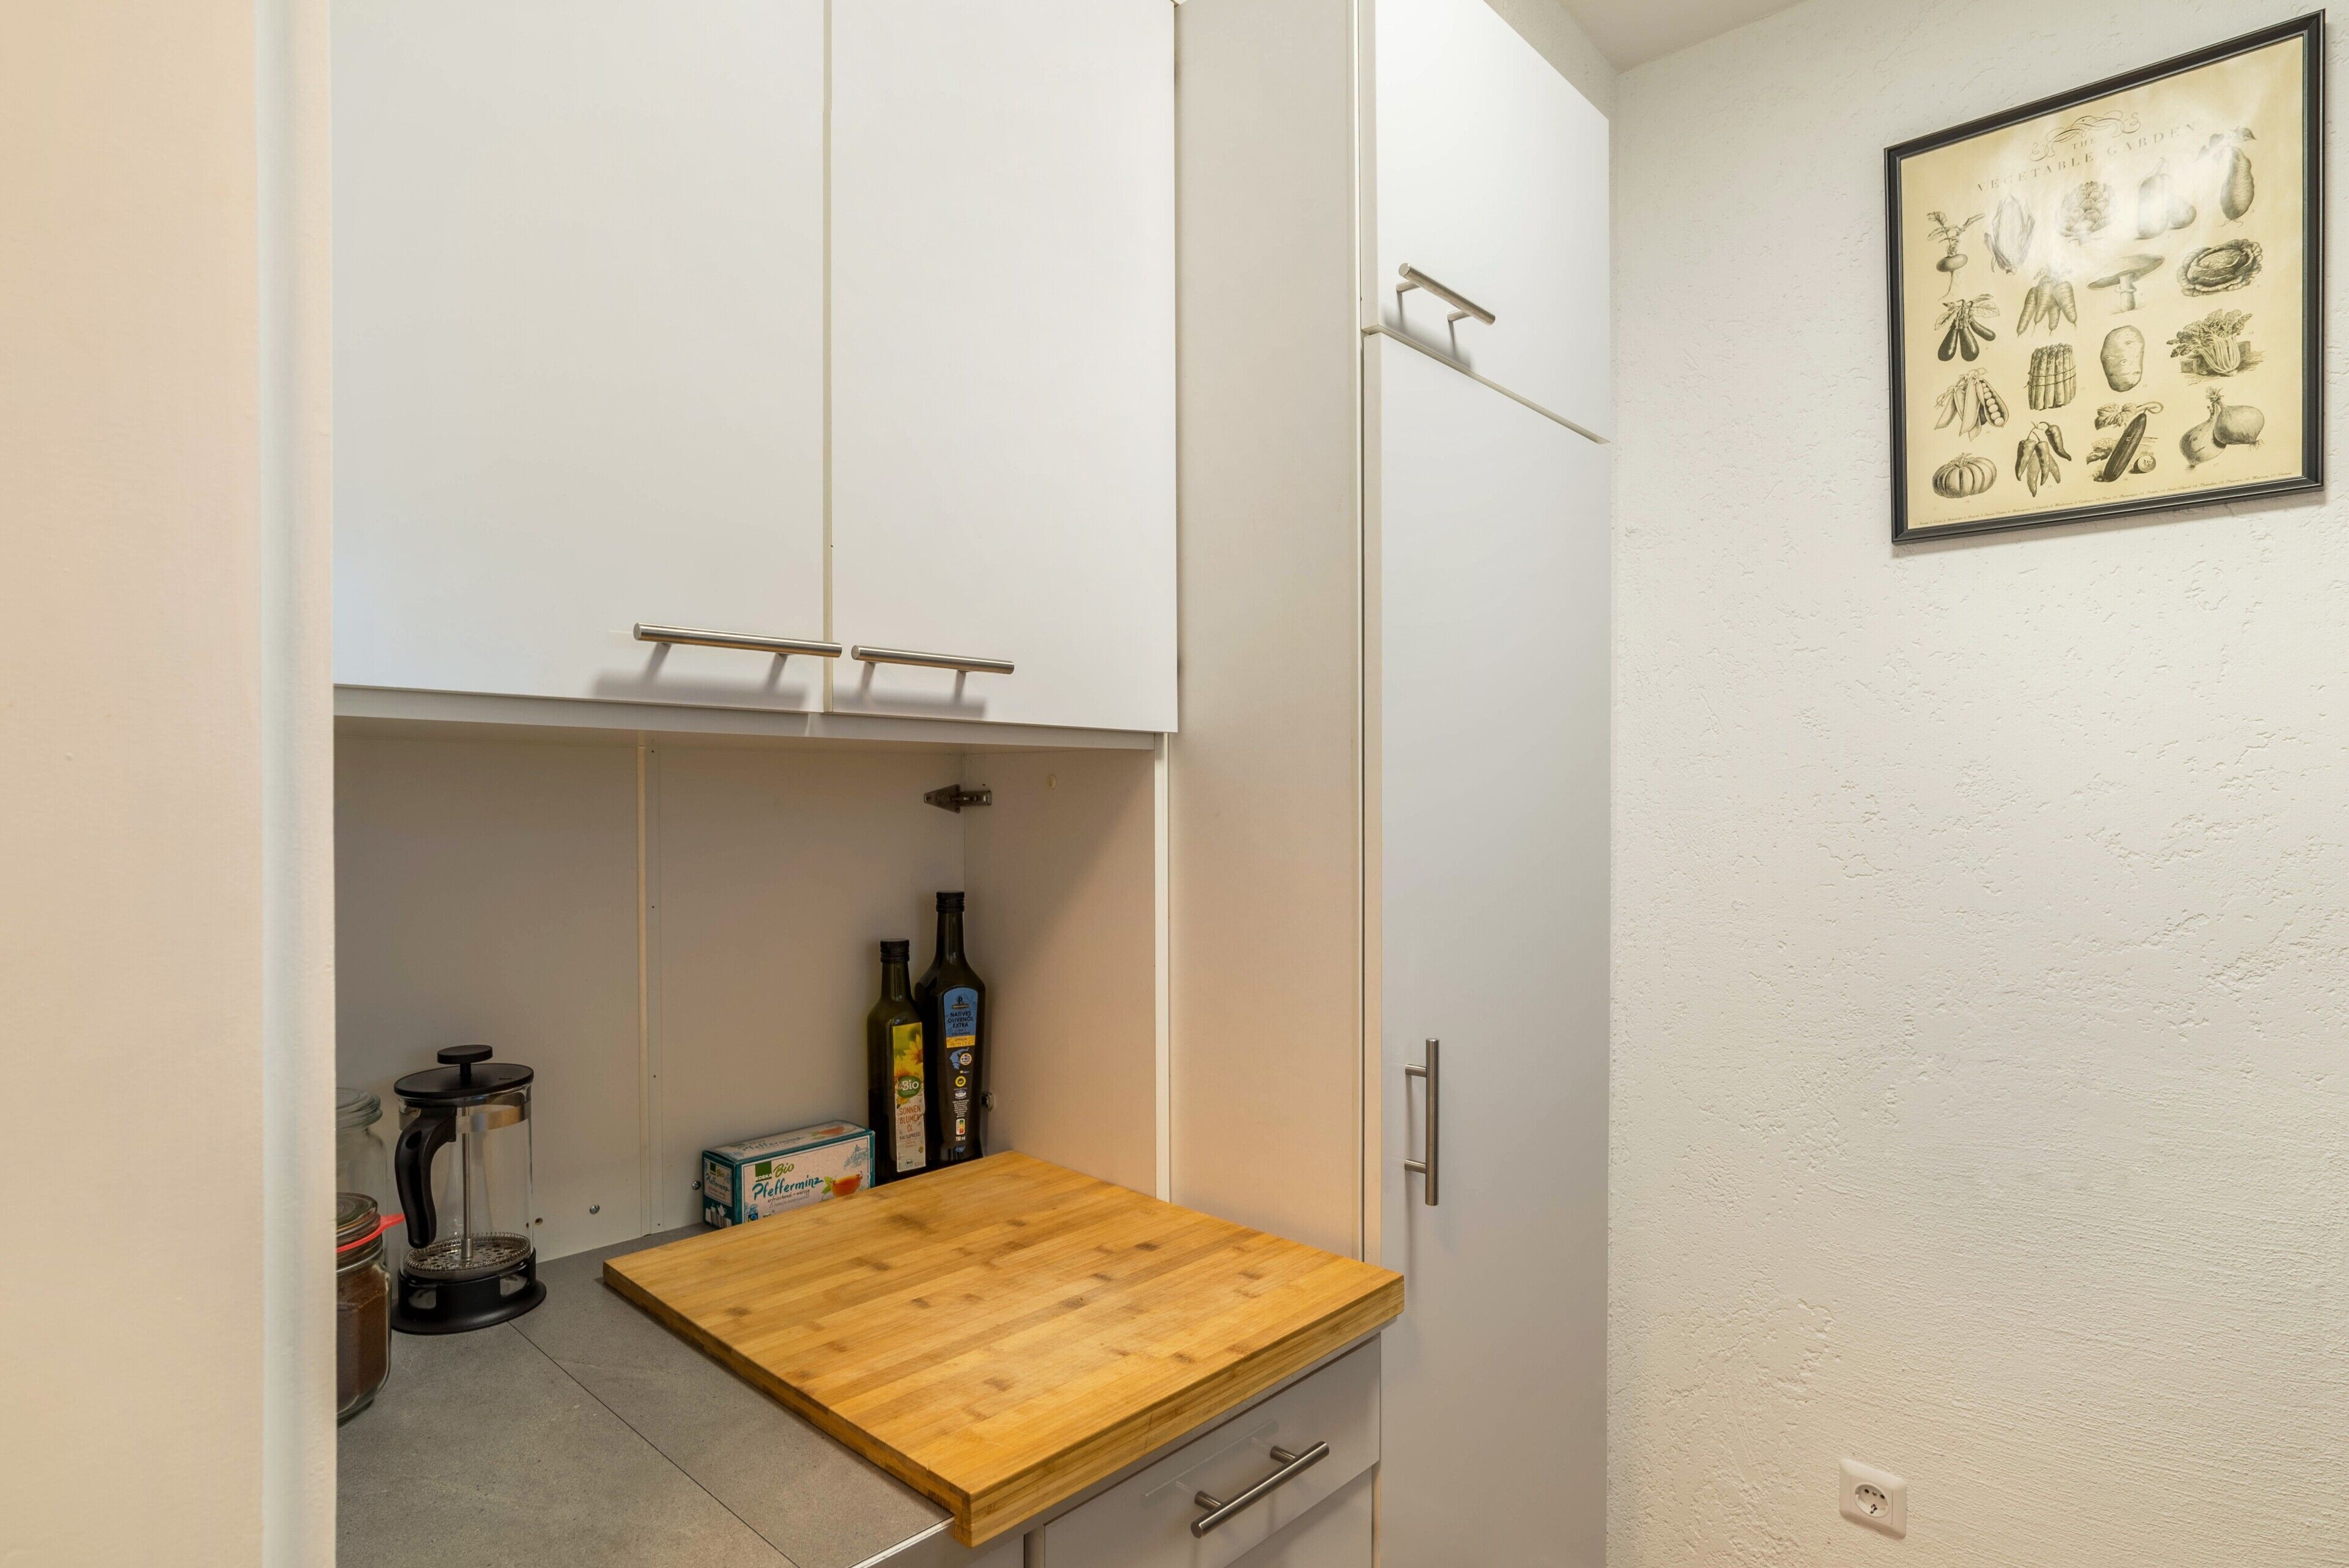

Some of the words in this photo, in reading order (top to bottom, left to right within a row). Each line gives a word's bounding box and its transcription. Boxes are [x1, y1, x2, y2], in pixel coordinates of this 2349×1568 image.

[2071, 136, 2097, 150] THE
[1976, 151, 2095, 192] VEGETABLE
[902, 1079, 919, 1091] Bio
[899, 1105, 921, 1116] SONNEN
[899, 1114, 921, 1124] BLUMEN
[716, 1169, 725, 1178] Bio
[773, 1162, 795, 1178] Bio
[752, 1174, 824, 1201] Pfefferminz
